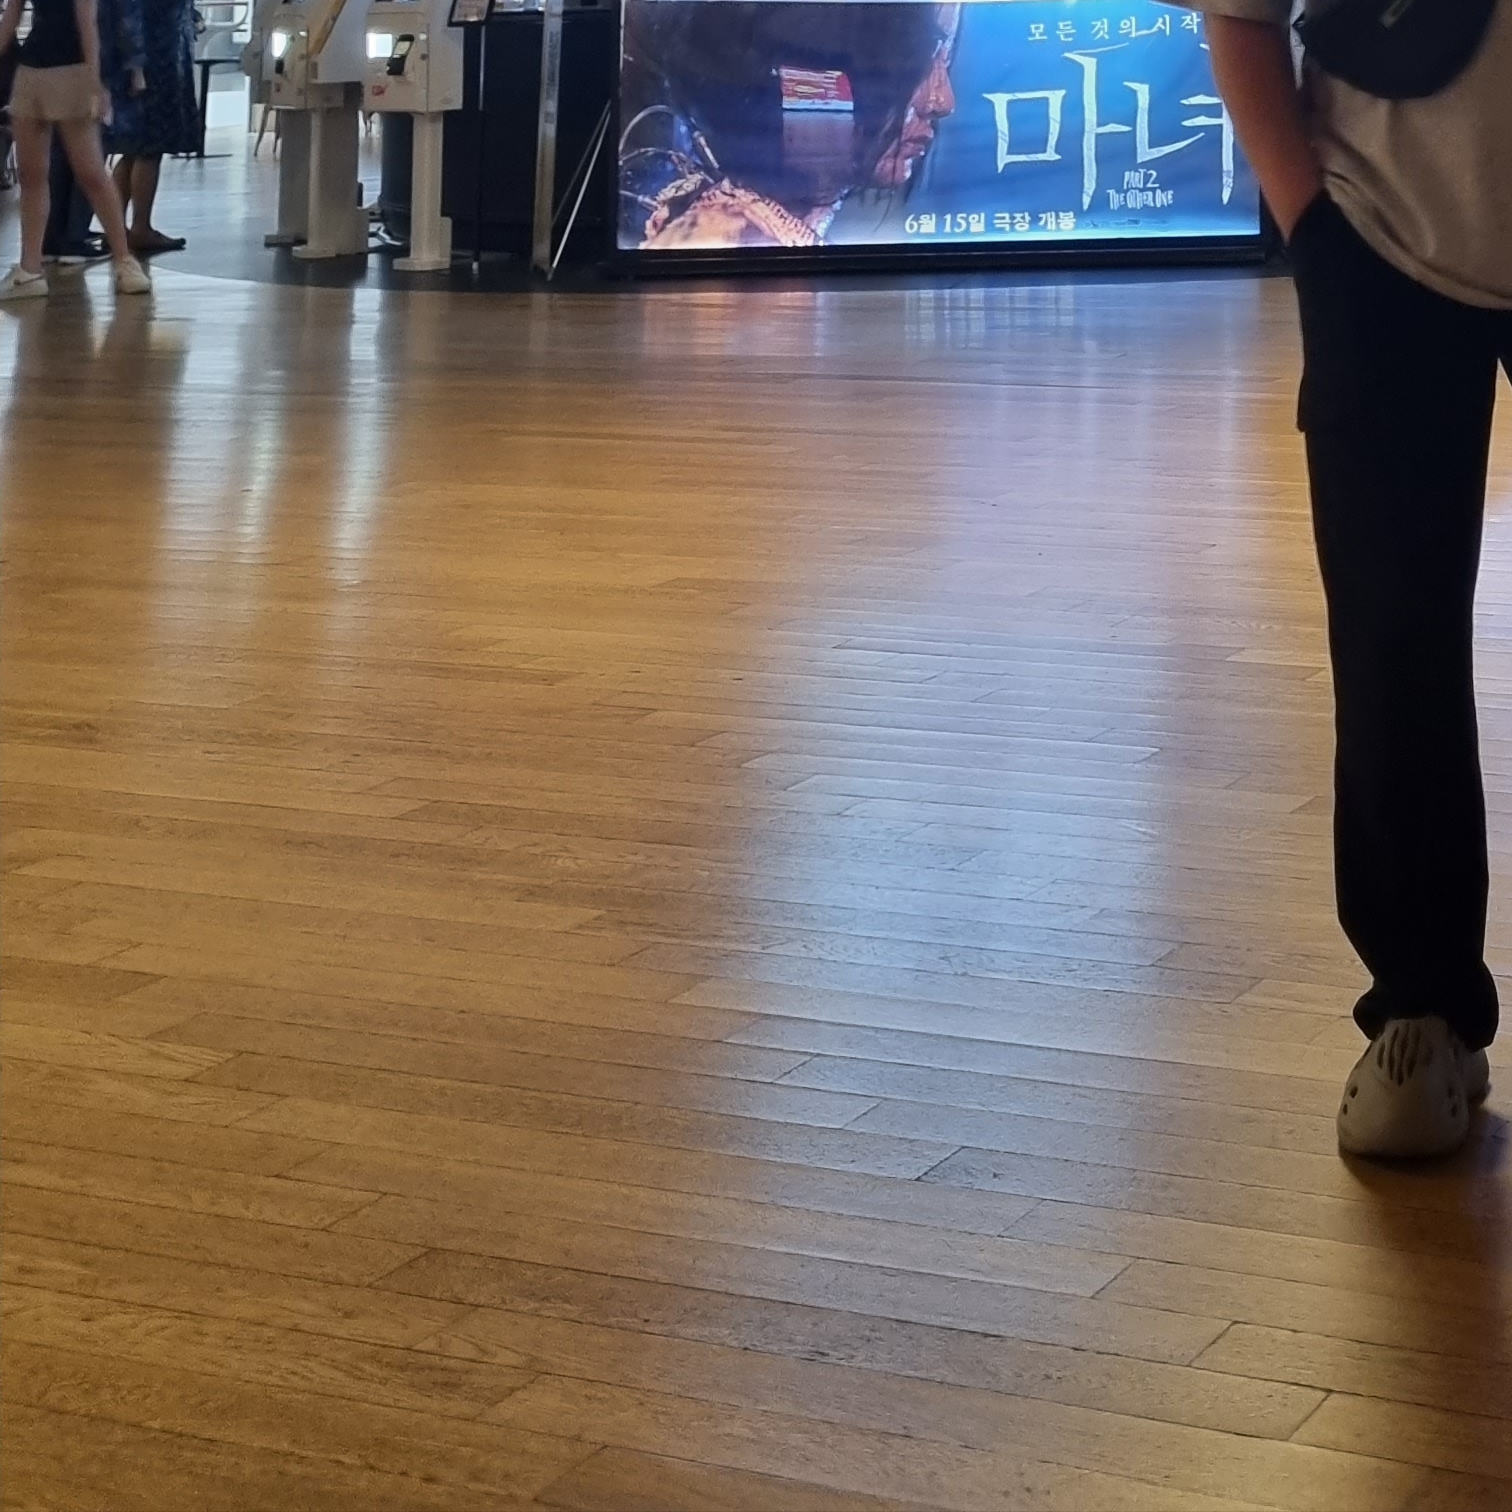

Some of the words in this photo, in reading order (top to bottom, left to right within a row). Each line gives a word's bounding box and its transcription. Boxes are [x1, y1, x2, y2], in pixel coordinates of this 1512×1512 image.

[1027, 20, 1077, 42] 모든
[982, 43, 1234, 212] 마녀
[1123, 168, 1146, 190] PART
[1145, 169, 1160, 188] 2
[1155, 188, 1174, 208] ONE
[904, 213, 936, 234] 6월
[943, 212, 986, 233] 15일
[993, 211, 1031, 232] 극장
[1038, 211, 1077, 231] 개봉
